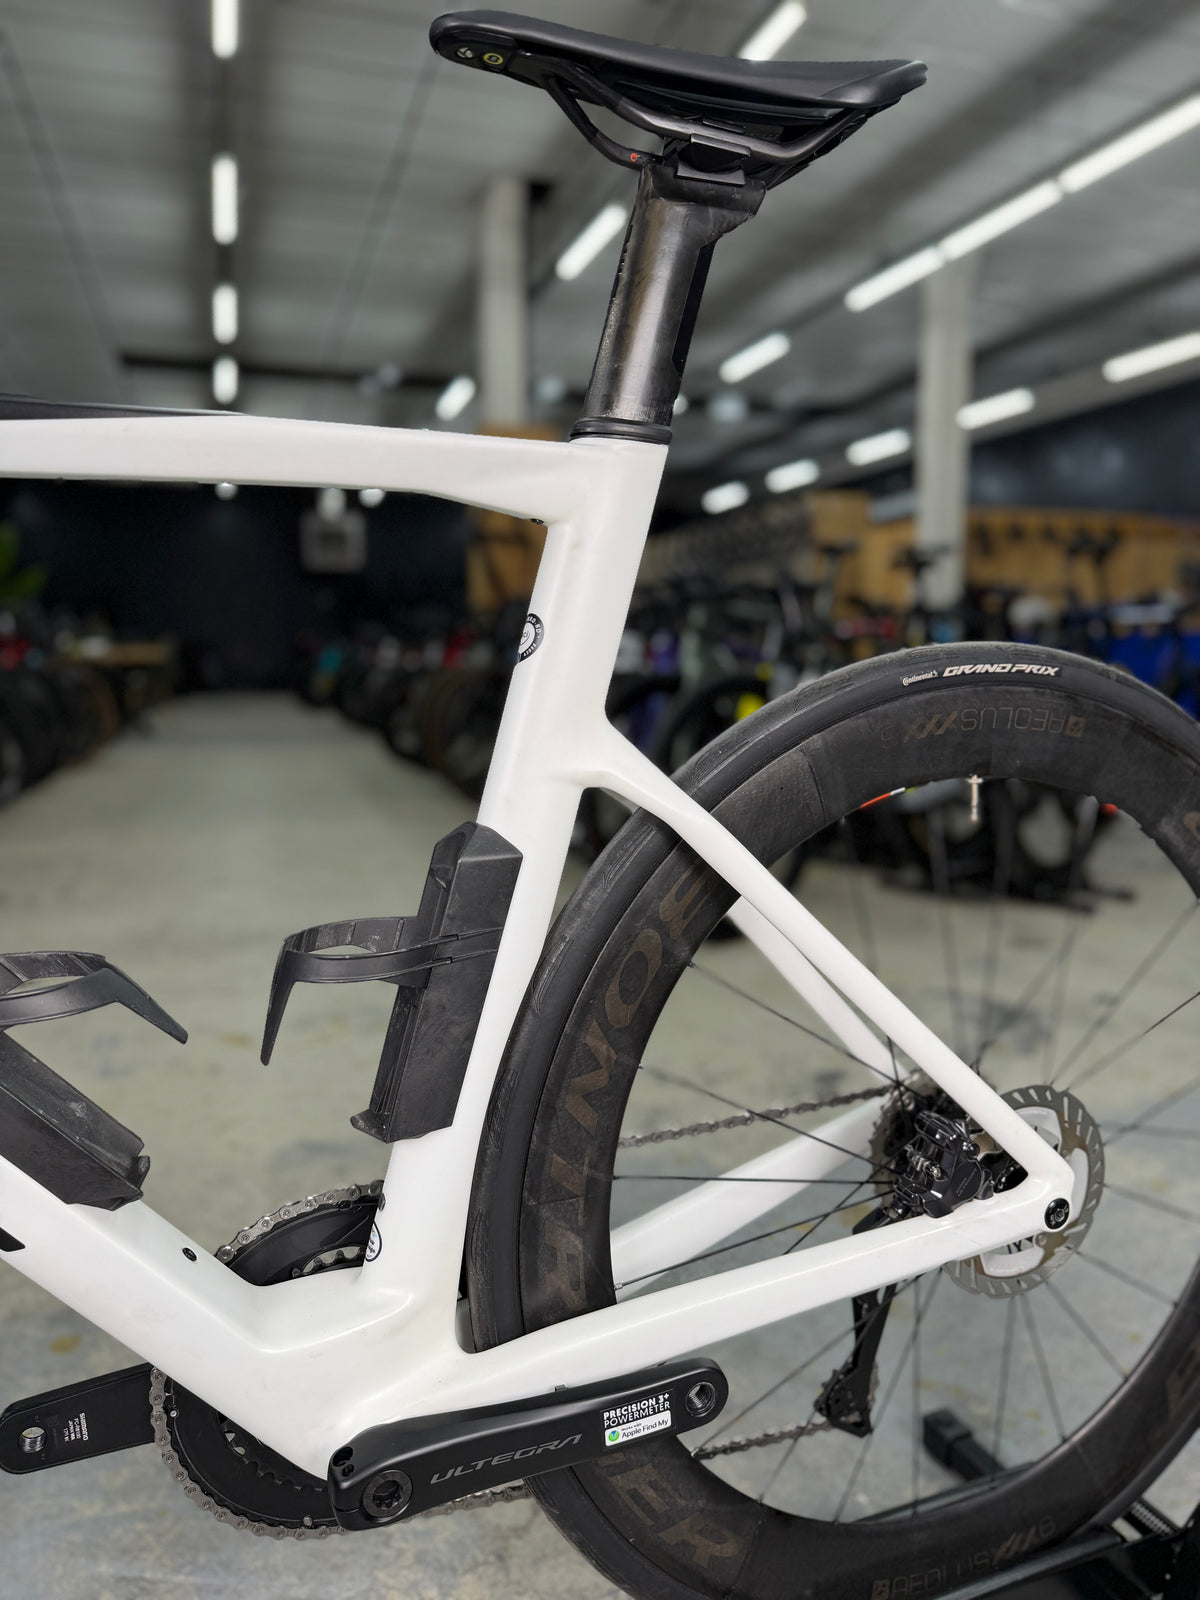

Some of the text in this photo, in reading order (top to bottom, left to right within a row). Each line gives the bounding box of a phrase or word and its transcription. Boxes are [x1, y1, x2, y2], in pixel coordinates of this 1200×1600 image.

[902, 664, 1060, 687] Continental GRAND PRIX
[960, 706, 1065, 734] AEOLUS
[604, 1393, 670, 1420] PRECISION 3+
[604, 1401, 671, 1429] POWERMETER
[621, 1418, 669, 1439] Apple Find My
[430, 1433, 582, 1485] ULTEGRA
